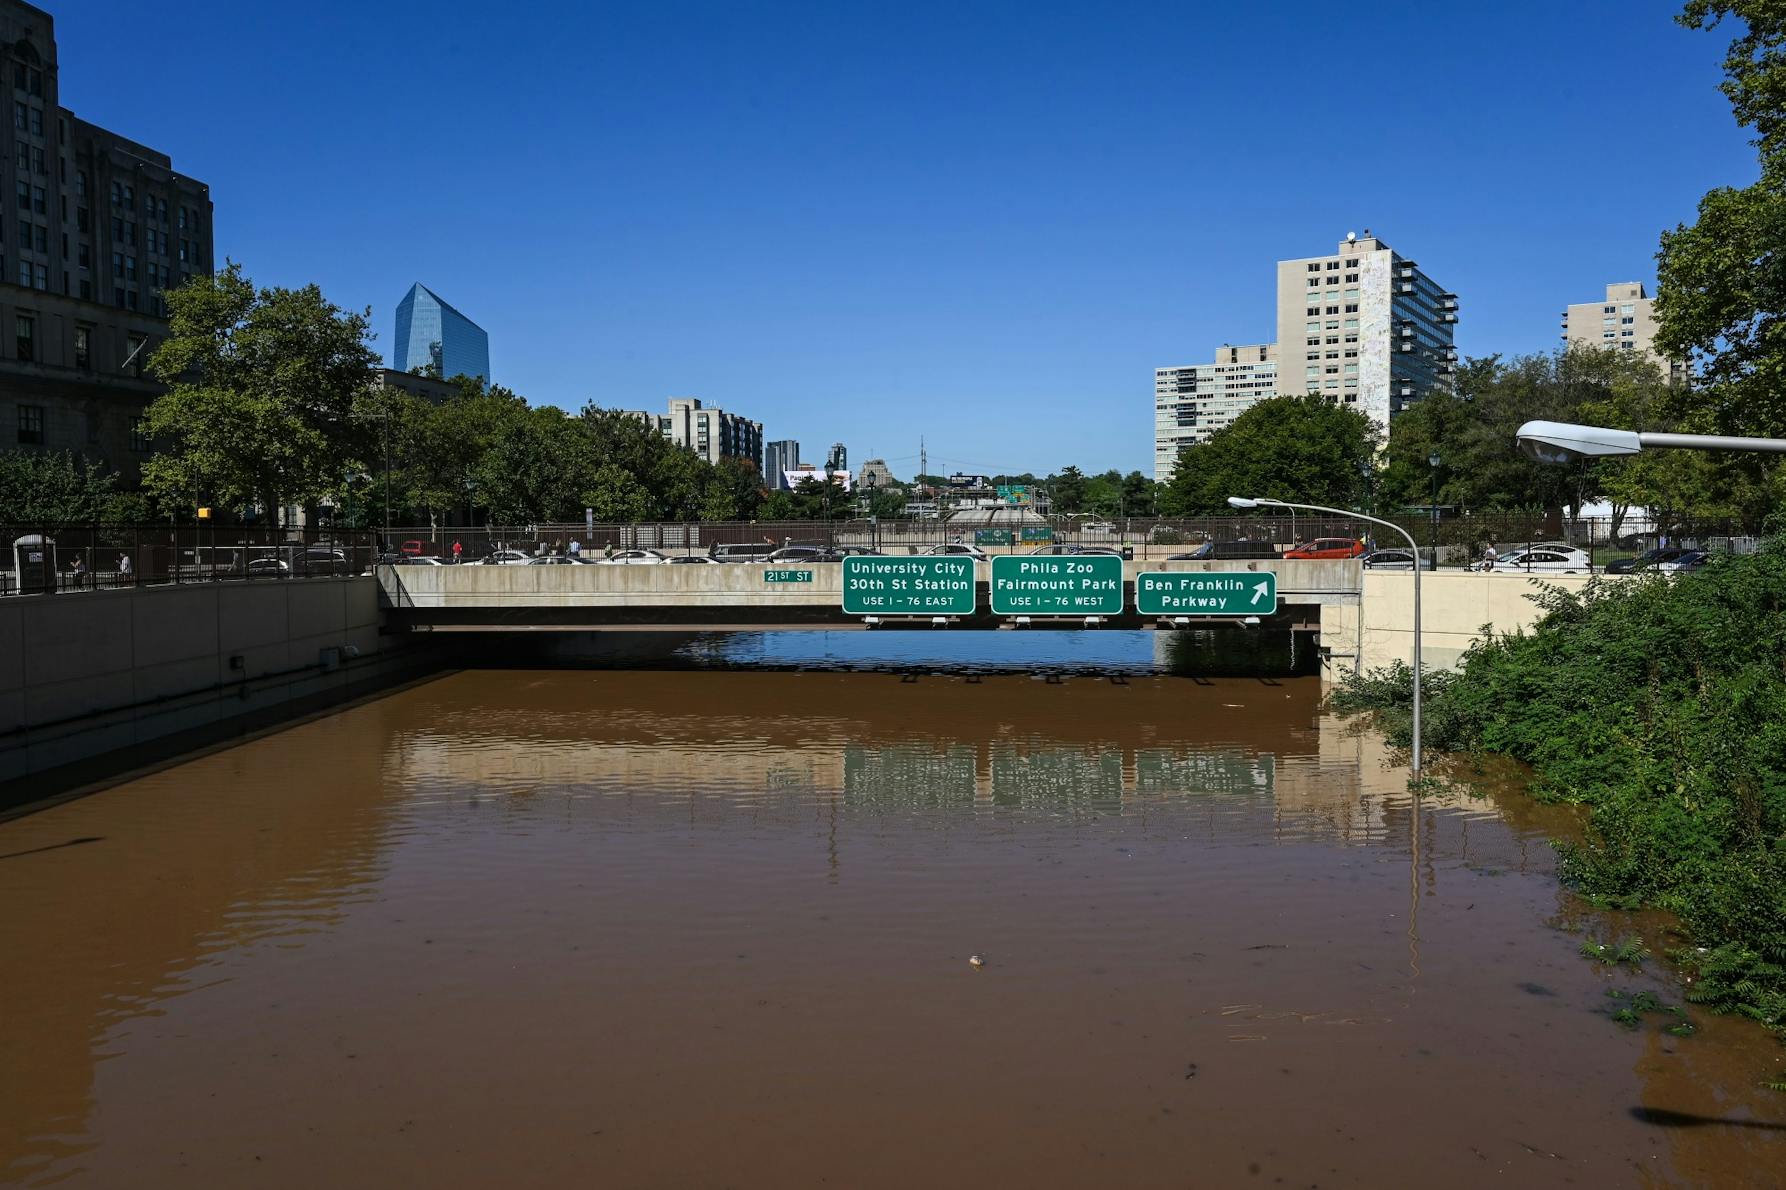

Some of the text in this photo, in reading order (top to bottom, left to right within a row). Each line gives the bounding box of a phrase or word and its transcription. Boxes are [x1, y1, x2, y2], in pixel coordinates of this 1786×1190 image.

[851, 562, 965, 577] University City
[1020, 562, 1094, 574] Phila Zoo
[767, 571, 809, 581] 21ST ST
[849, 578, 968, 590] 30th St Station
[997, 578, 1116, 590] Fairmount Park
[1145, 579, 1244, 591] Ben Franklin
[862, 596, 884, 606] USE
[925, 596, 954, 606] EAST
[1010, 596, 1032, 606] USE
[1074, 596, 1104, 606] WEST
[1161, 595, 1228, 610] Parkway
